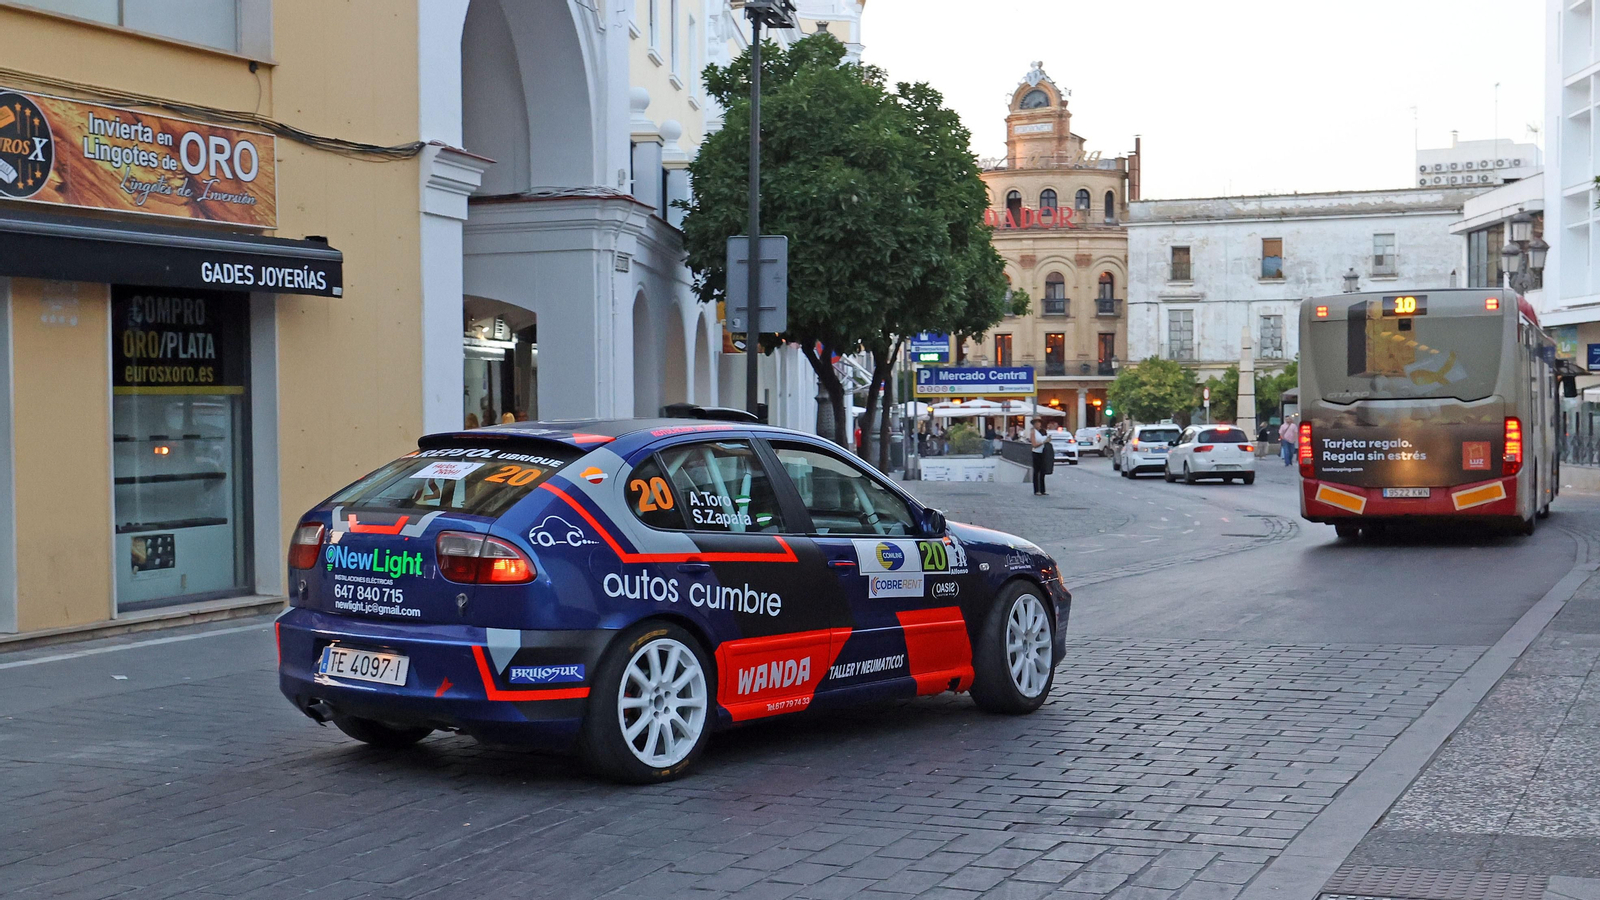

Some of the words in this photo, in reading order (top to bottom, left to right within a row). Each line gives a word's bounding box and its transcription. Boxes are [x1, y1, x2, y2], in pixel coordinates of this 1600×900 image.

[88, 111, 153, 143] Invierta
[157, 132, 173, 146] en
[83, 137, 158, 168] Lingotes
[162, 154, 178, 171] de
[179, 131, 259, 183] ORO
[120, 165, 172, 206] Lingotes
[176, 177, 193, 198] de
[197, 179, 257, 205] Inversión
[201, 261, 254, 286] GADES
[257, 264, 327, 290] JOYERÍAS
[132, 295, 206, 326] COMPRO
[1394, 296, 1417, 314] 10
[123, 330, 216, 359] ORO/PLATA
[125, 366, 214, 383] eurosxoro.es
[920, 370, 930, 383] P
[939, 370, 986, 381] Mercado
[1322, 438, 1366, 450] Tarjeta
[1368, 438, 1412, 450] regalo.
[414, 448, 501, 459] REPSOL
[498, 453, 565, 468] UBRIQUE
[1322, 451, 1365, 463] Regala
[1367, 451, 1385, 461] sin
[1387, 451, 1427, 461] estrés
[485, 465, 542, 486] 20
[630, 477, 674, 512] 20
[690, 491, 731, 507] A.Toro
[1388, 488, 1410, 497] 9522
[693, 509, 752, 527] S.Zapata
[335, 545, 423, 578] NewLight
[920, 541, 946, 570] 20
[334, 584, 354, 599] 647
[357, 586, 380, 602] 840
[382, 588, 404, 603] 715
[603, 569, 679, 603] autos
[689, 583, 782, 617] cumbre
[876, 578, 923, 591] COBRERENT
[738, 656, 810, 695] WANDA
[829, 662, 855, 680] TALLER
[855, 660, 862, 676] Y
[860, 654, 905, 674] NEUMATICOS
[802, 697, 810, 705] 33
